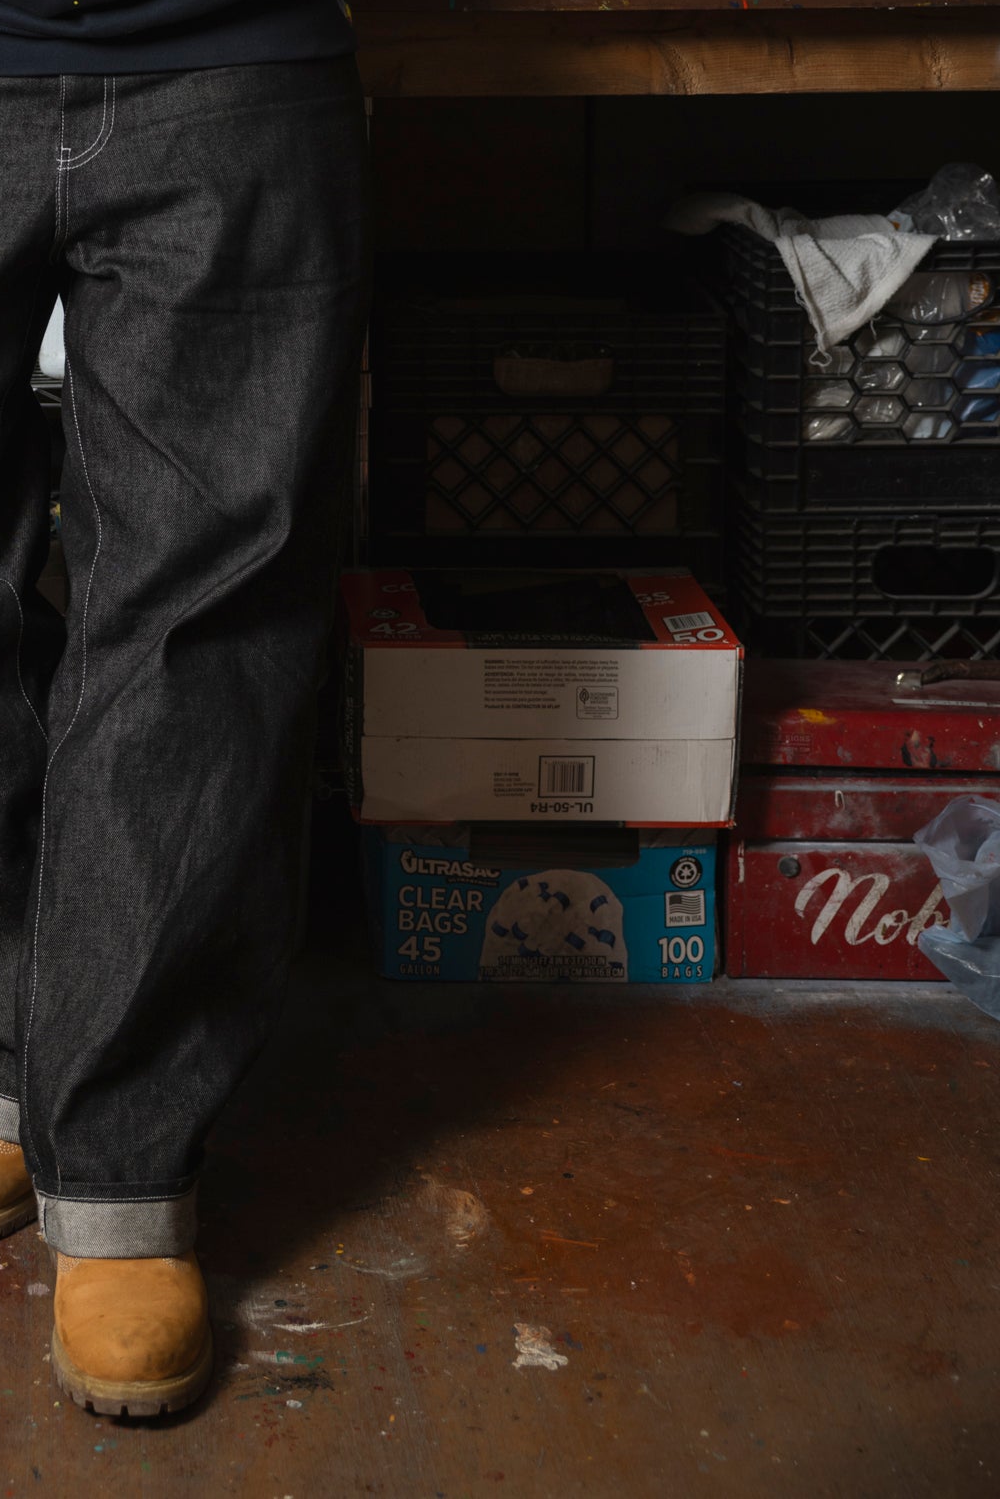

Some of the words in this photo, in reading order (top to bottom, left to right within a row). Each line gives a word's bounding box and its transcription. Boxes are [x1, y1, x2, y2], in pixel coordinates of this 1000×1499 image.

[369, 621, 419, 635] 42
[530, 802, 594, 813] UL-50-R4
[398, 885, 484, 912] CLEAR
[794, 868, 950, 946] Nob
[398, 909, 468, 935] BAGS
[398, 935, 442, 963] 45
[657, 934, 705, 964] 100
[399, 963, 441, 976] GALLON
[662, 965, 703, 978] BAGS
